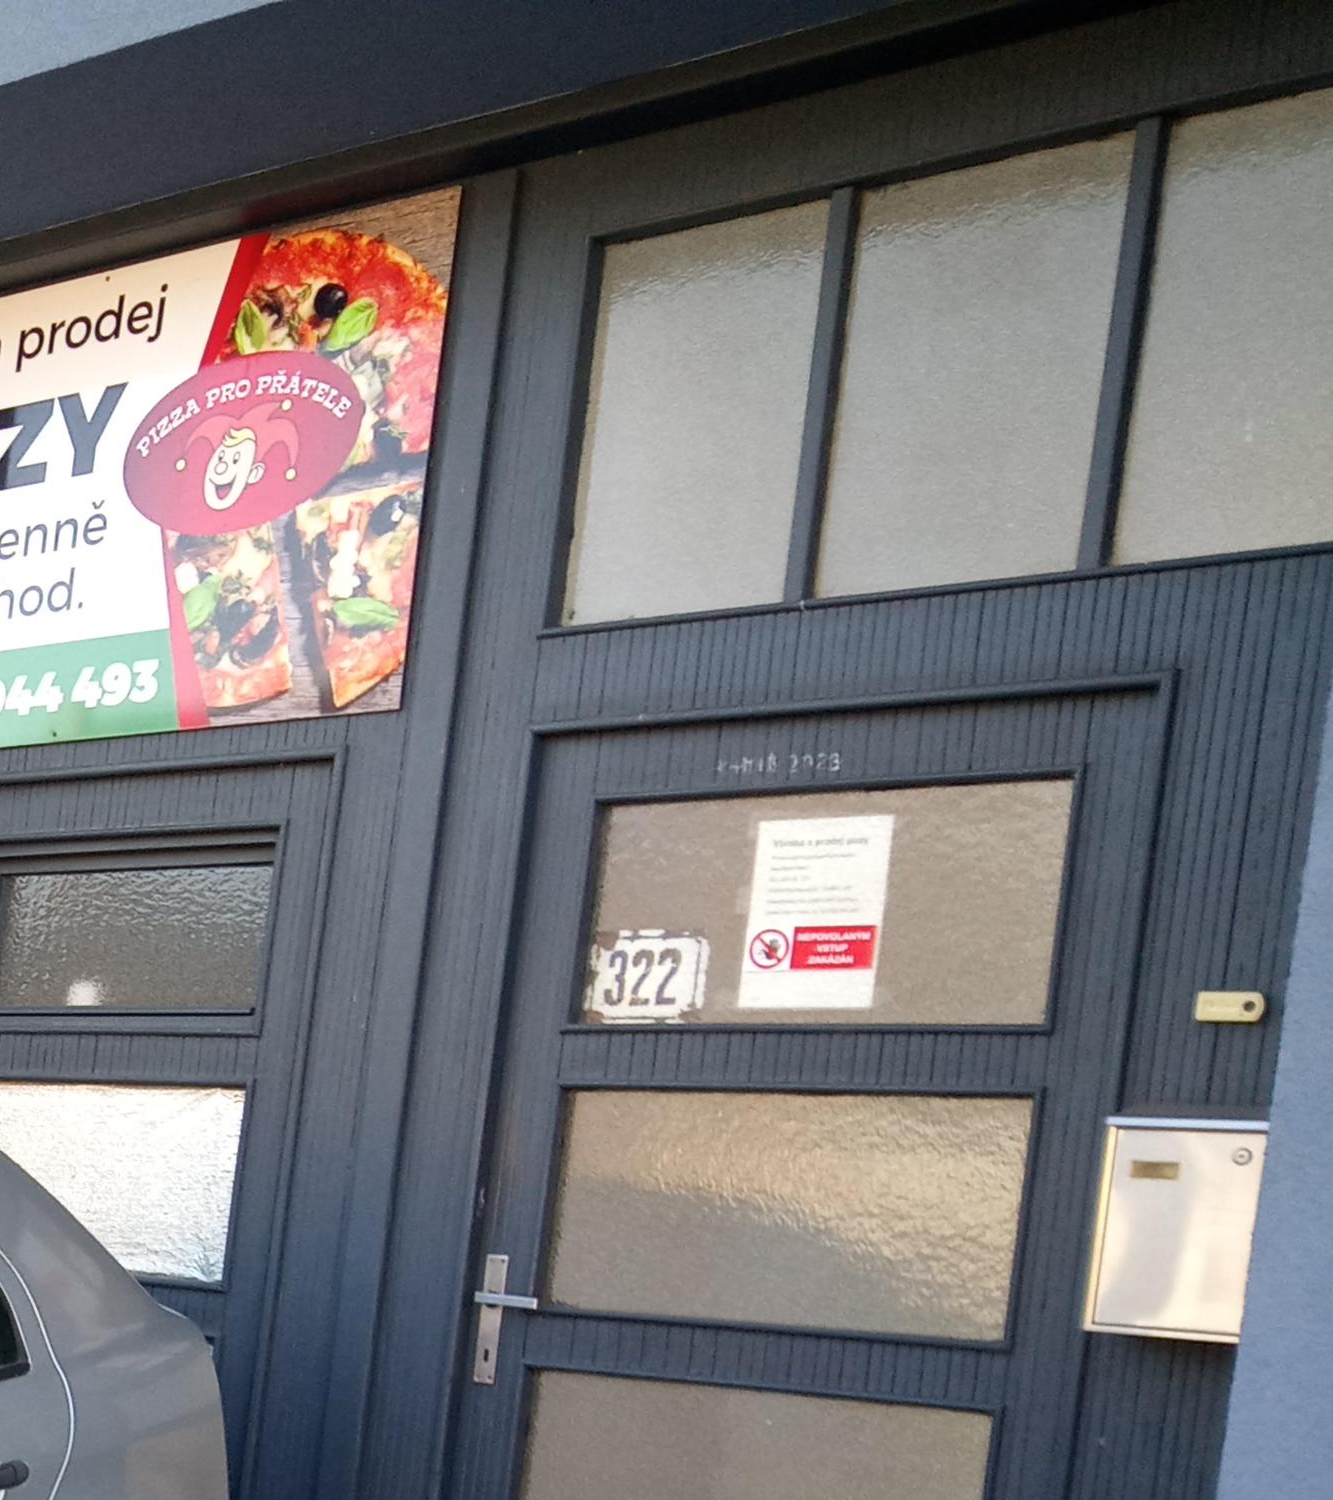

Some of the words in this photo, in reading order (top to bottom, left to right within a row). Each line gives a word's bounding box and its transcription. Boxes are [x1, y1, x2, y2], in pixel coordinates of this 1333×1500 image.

[15, 283, 169, 373] prodej
[135, 397, 202, 458] PIZZA
[205, 379, 251, 409] PRO
[255, 369, 353, 420] PŘÁTELE
[70, 658, 160, 708] 493
[603, 947, 683, 1007] 322
